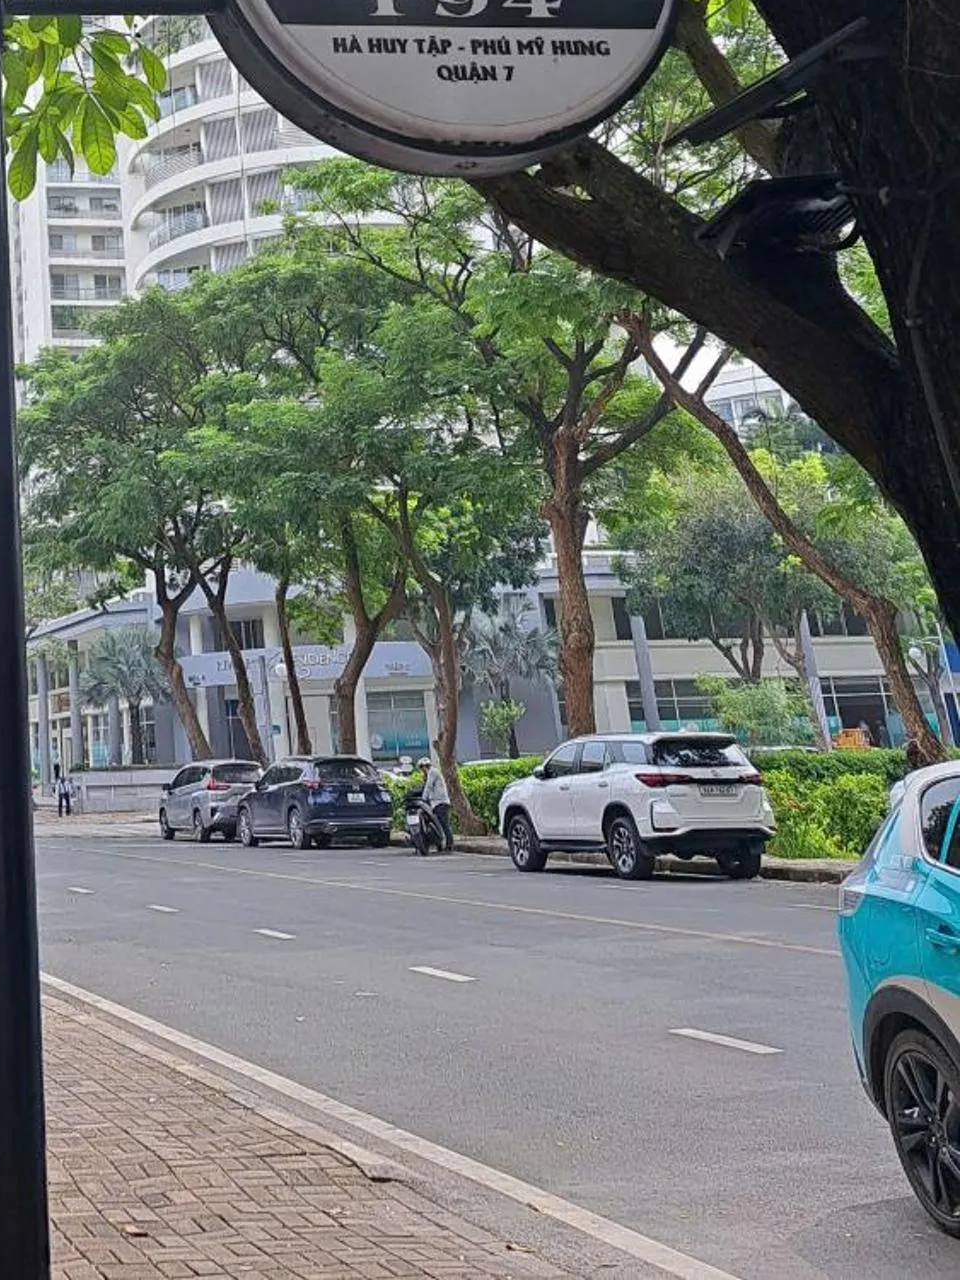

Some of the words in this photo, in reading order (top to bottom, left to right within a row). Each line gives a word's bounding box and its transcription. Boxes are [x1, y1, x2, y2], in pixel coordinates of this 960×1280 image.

[332, 34, 363, 54] HÀ
[367, 37, 408, 54] HUY
[413, 35, 453, 58] TẬP
[470, 35, 512, 56] PHÚ
[516, 36, 545, 56] MỸ
[436, 61, 498, 84] QUẬN
[503, 65, 515, 82] 7
